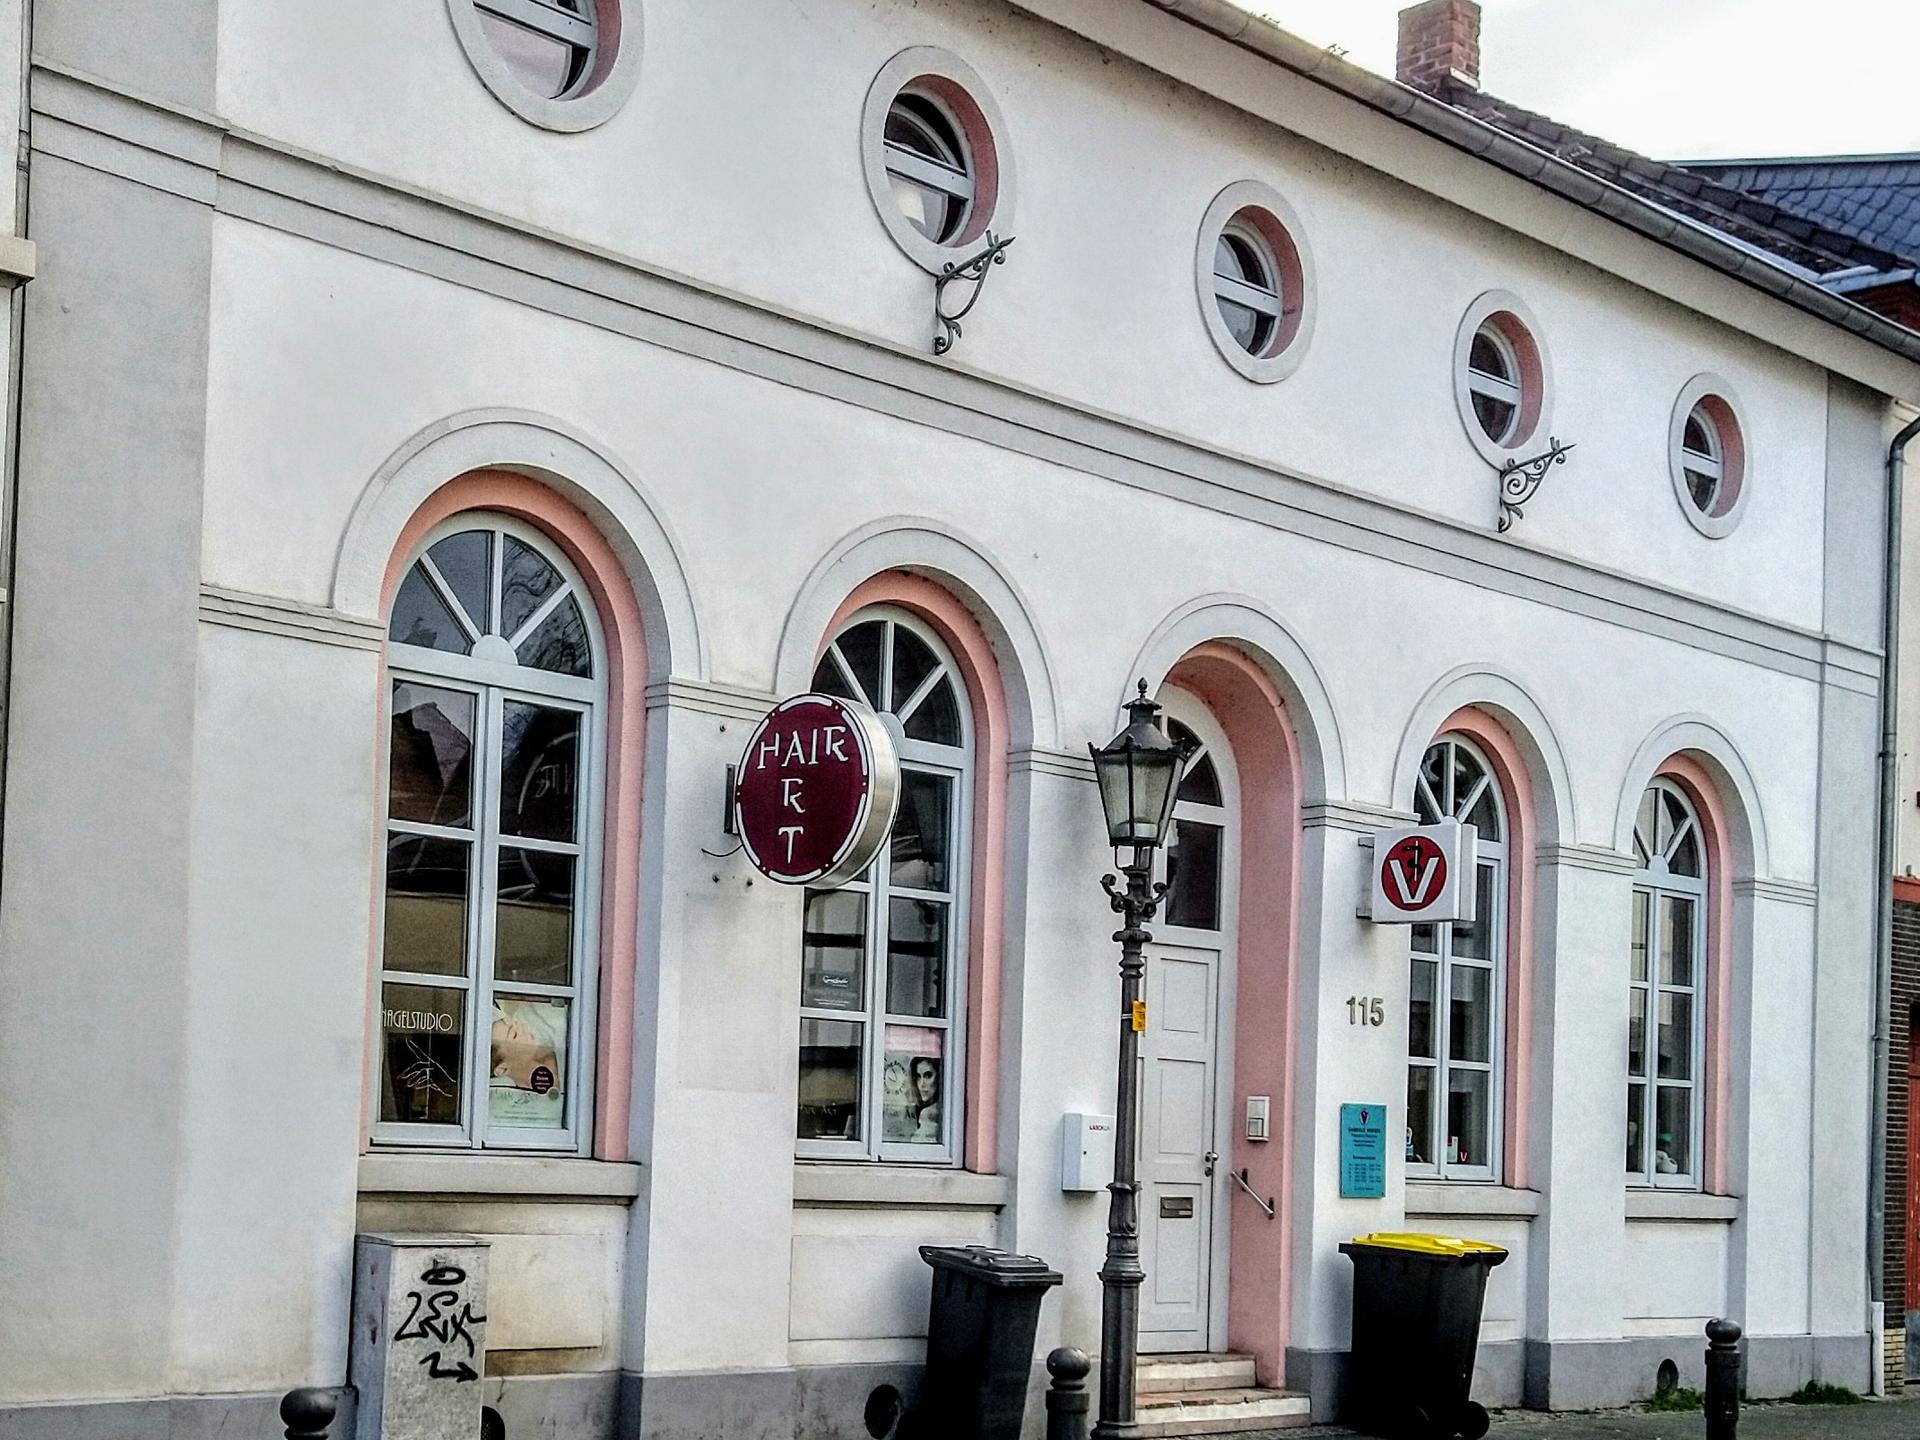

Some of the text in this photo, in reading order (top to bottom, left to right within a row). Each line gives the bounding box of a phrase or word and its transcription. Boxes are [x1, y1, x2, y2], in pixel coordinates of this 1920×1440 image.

[757, 726, 849, 770] HAIR
[1389, 856, 1440, 904] V
[1346, 995, 1385, 1027] 115
